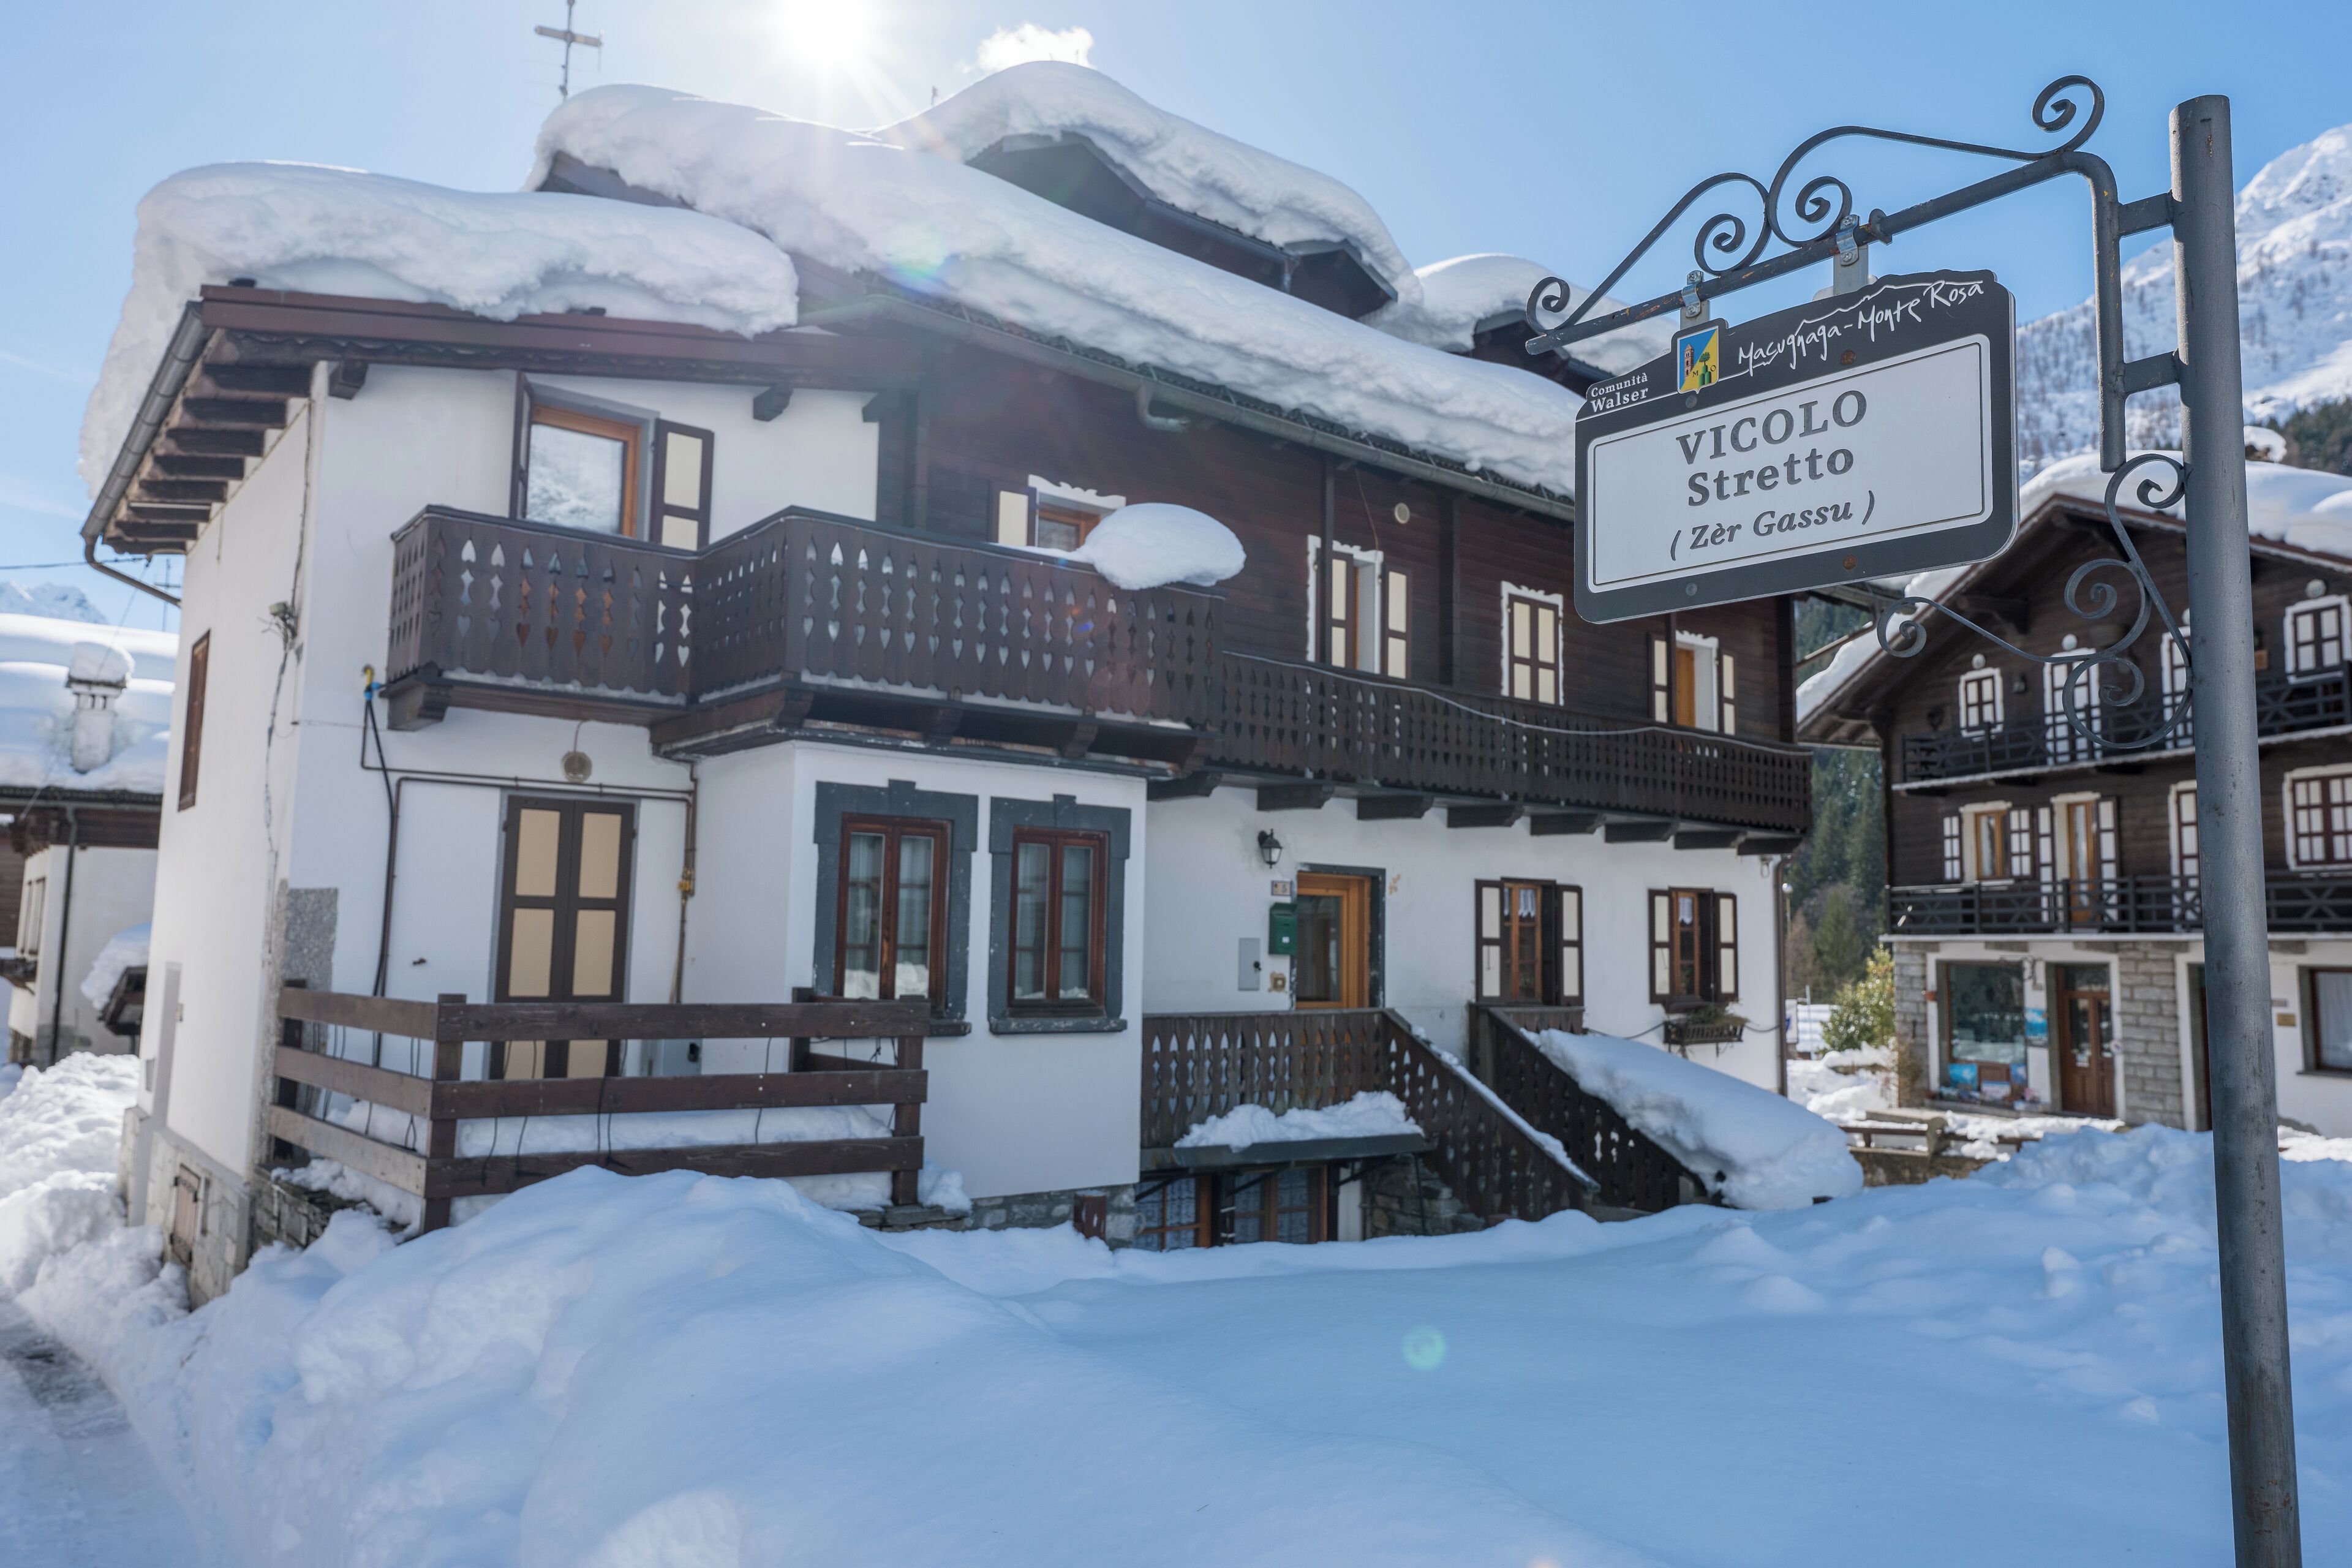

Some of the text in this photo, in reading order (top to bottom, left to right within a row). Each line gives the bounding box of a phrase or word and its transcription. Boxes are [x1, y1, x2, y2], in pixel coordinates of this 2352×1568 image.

[1923, 281, 1984, 308] Rosa
[1591, 372, 1648, 397] Comunità
[1591, 387, 1648, 413] Walser
[1676, 390, 1866, 465] VICOLO
[1688, 448, 1853, 506] Stretto
